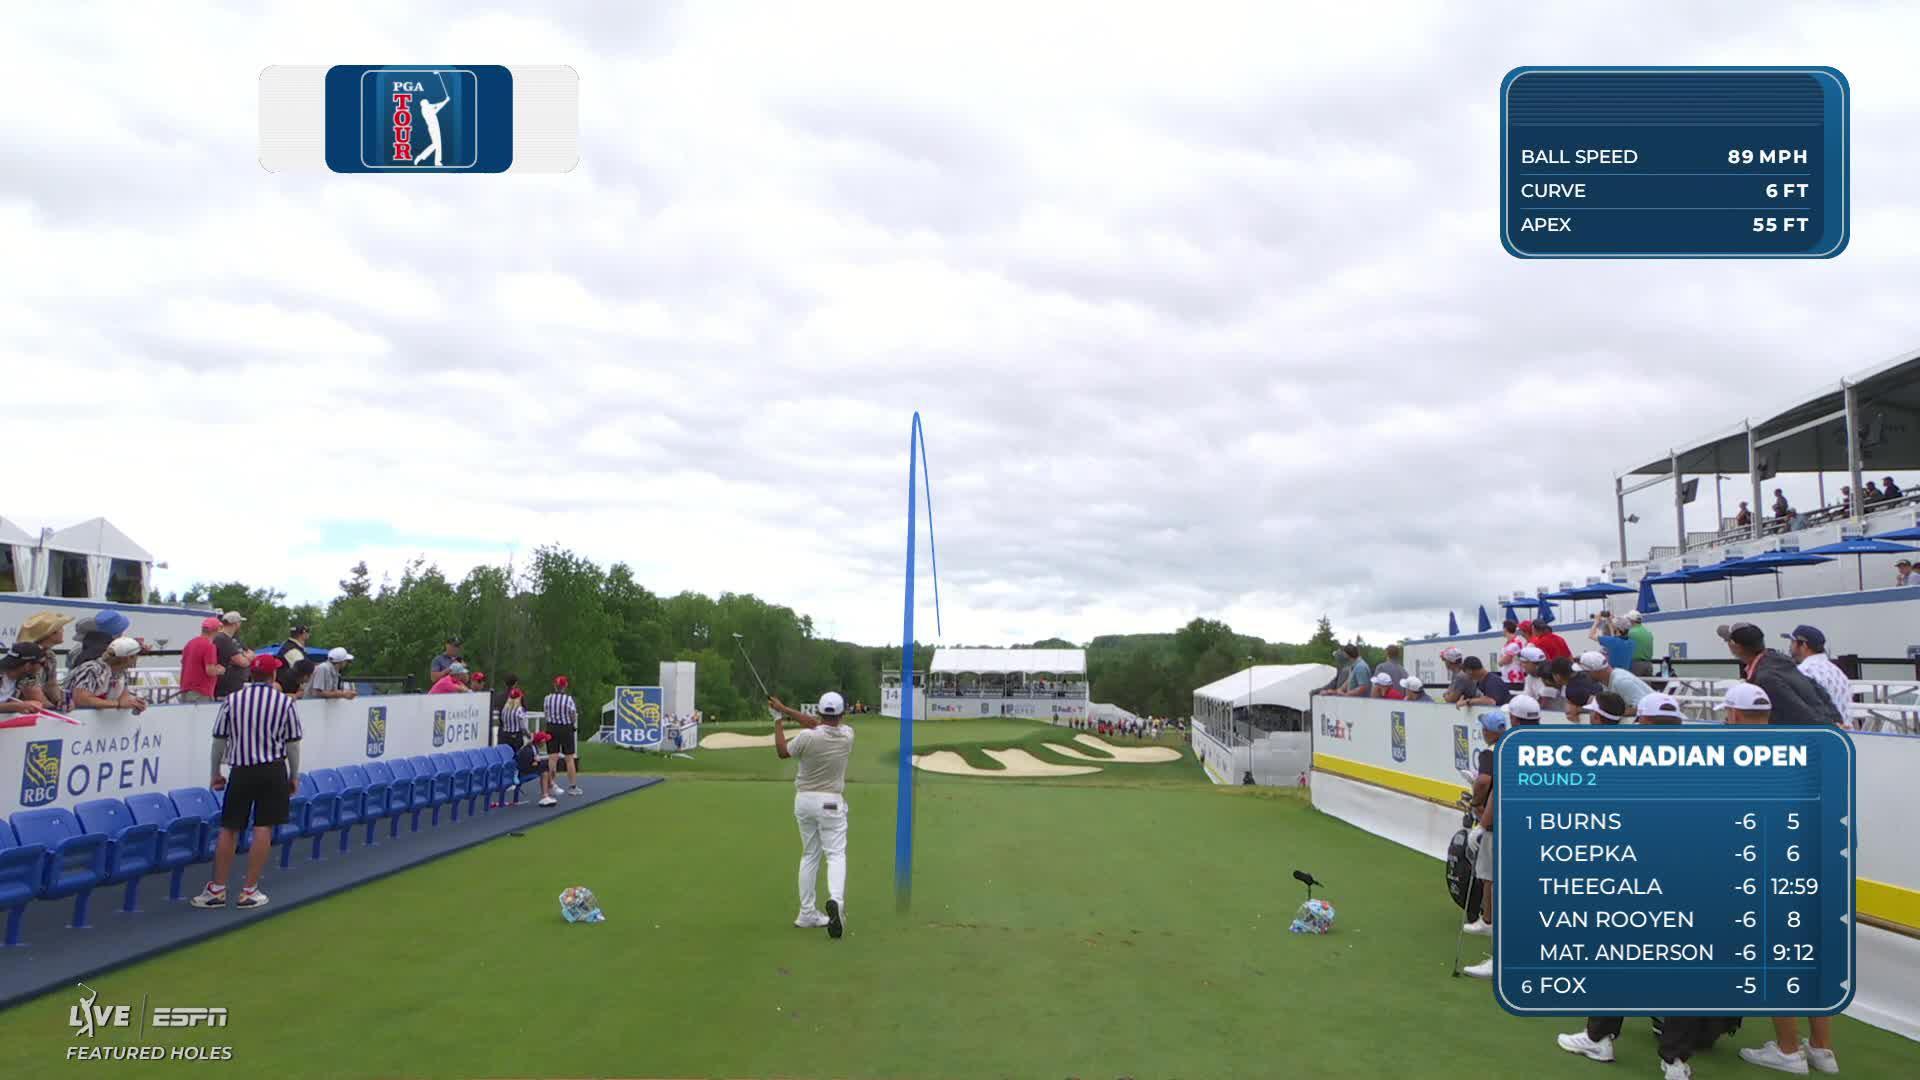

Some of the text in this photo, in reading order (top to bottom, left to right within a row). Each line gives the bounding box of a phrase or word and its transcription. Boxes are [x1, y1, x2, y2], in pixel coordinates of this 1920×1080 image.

[885, 688, 898, 700] 14
[71, 726, 162, 756] CANADIAN
[446, 722, 479, 743] OPEN
[620, 728, 659, 742] RBC
[367, 742, 384, 755] RBC
[67, 756, 160, 796] OPEN
[23, 786, 55, 804] RBC
